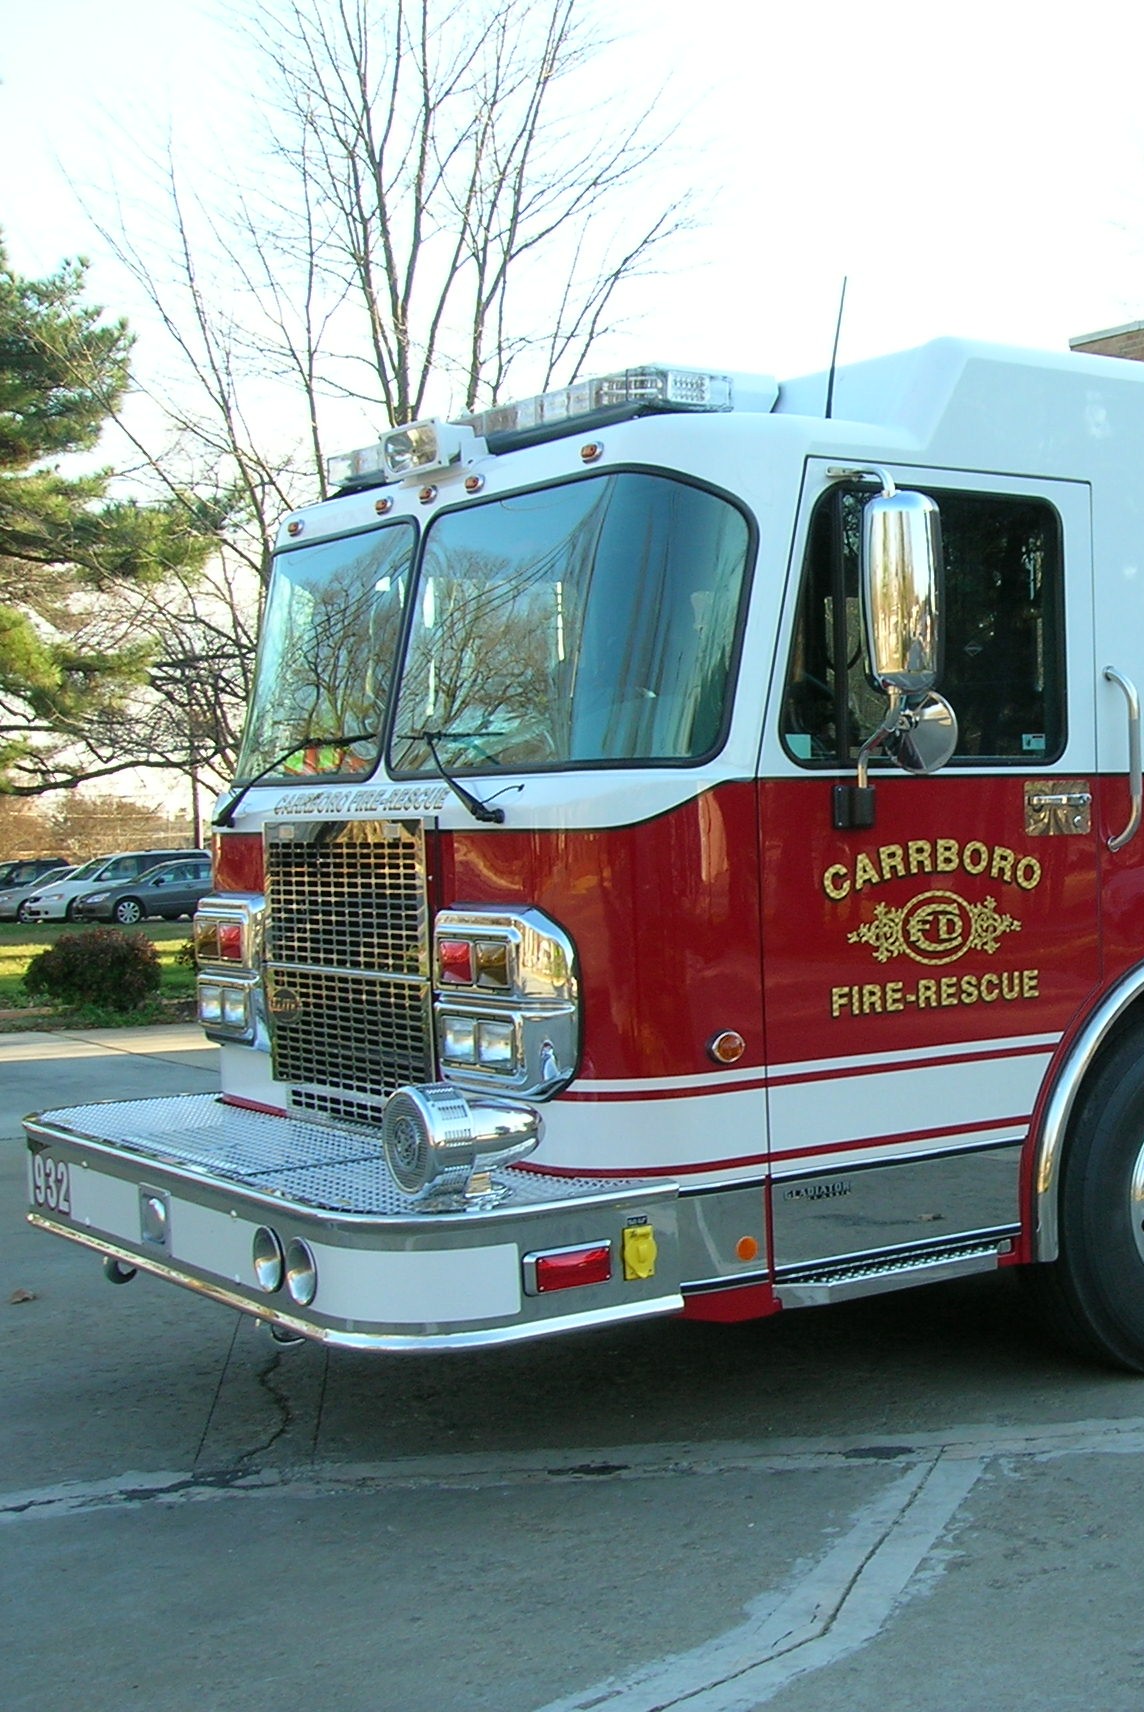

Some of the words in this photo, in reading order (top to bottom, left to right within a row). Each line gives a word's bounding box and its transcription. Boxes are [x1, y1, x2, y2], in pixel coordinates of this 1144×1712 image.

[347, 787, 450, 812] FIRE-RESCUE
[823, 839, 1042, 900] CARRBORO
[831, 969, 1040, 1017] FIRE-RESCUE
[34, 1154, 71, 1215] 932
